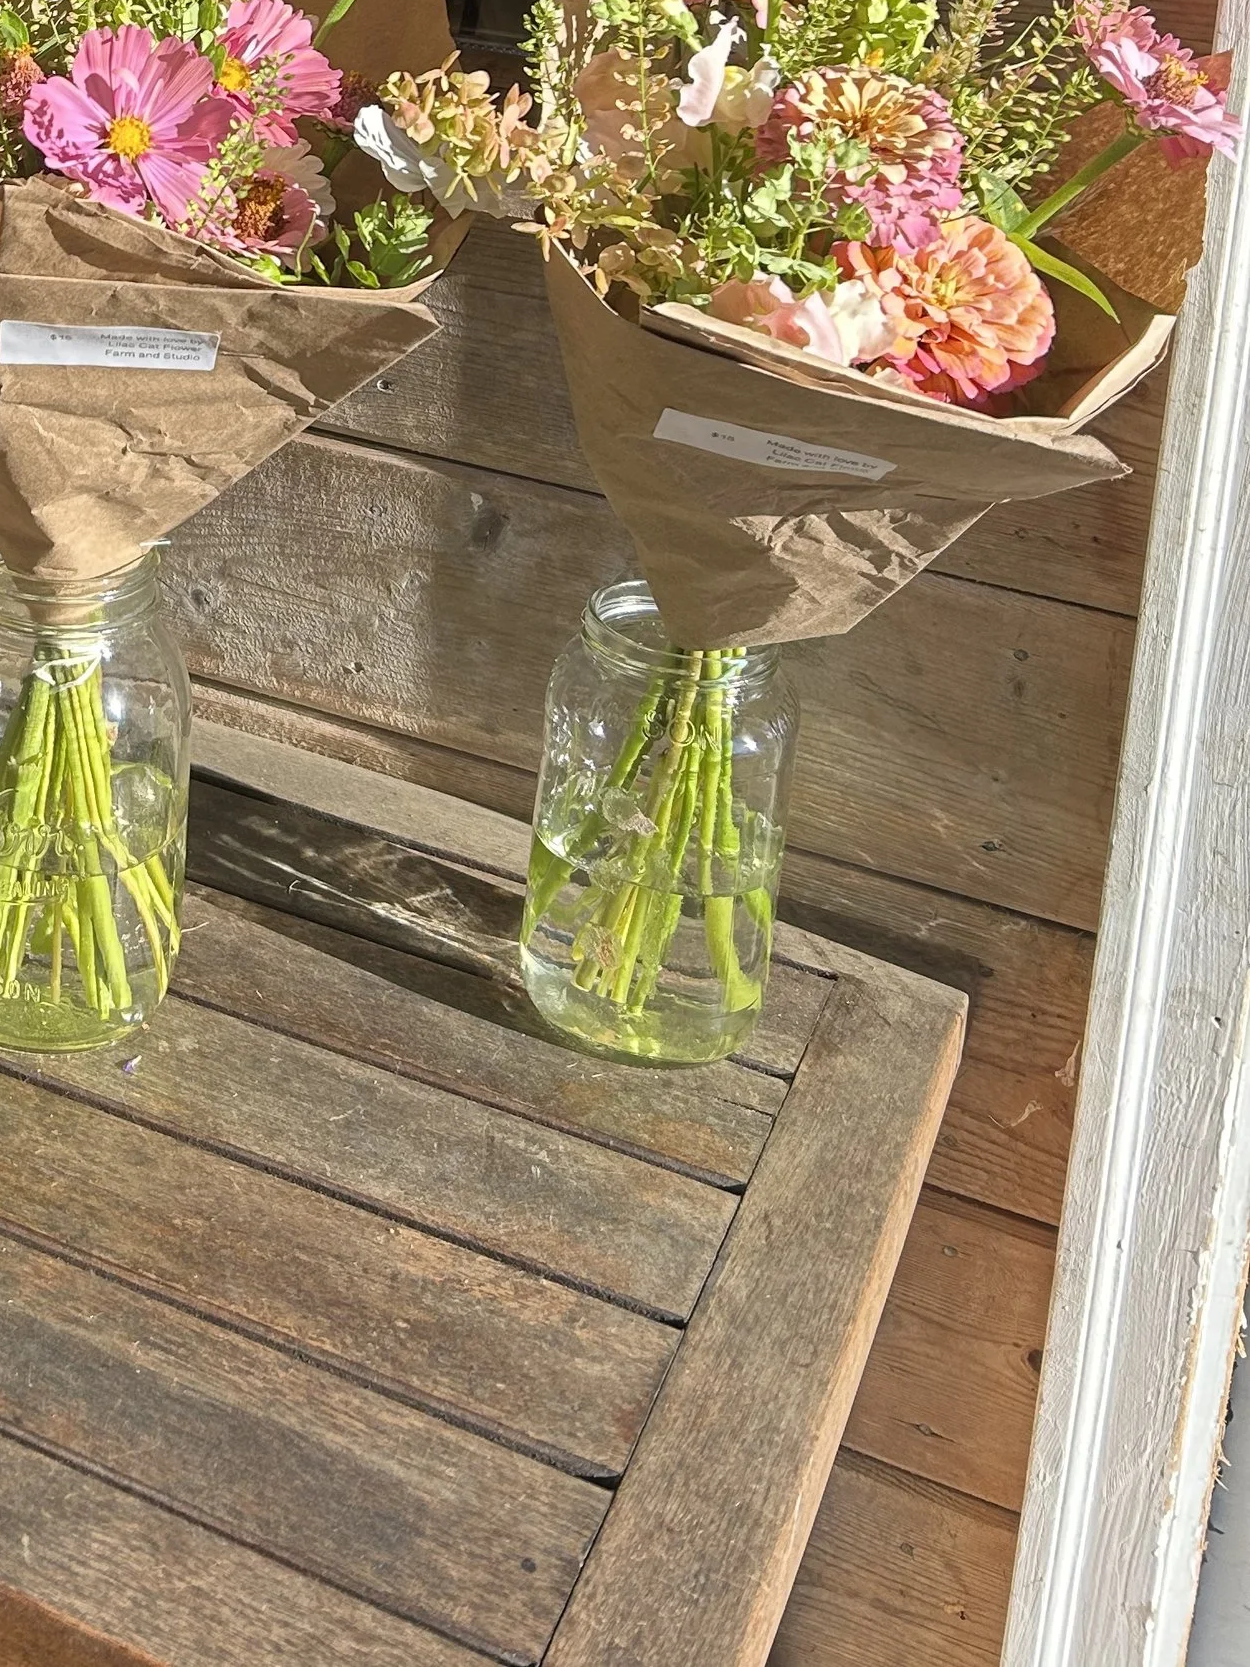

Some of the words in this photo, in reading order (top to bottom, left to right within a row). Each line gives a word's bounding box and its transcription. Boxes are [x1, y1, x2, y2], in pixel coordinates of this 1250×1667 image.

[100, 333, 133, 342] Made
[136, 335, 160, 343] with
[163, 336, 188, 344] love
[189, 338, 204, 346] by
[108, 341, 136, 349] Lilac
[138, 342, 160, 351] Cat
[163, 344, 203, 352] Flower
[104, 349, 136, 359] Farm
[138, 351, 161, 360] and
[163, 353, 201, 362] Studio
[766, 439, 801, 454] Made
[804, 451, 831, 461] with
[833, 455, 860, 466] love
[862, 461, 879, 471] by
[772, 449, 801, 462] Lilac
[804, 458, 827, 467] Cat
